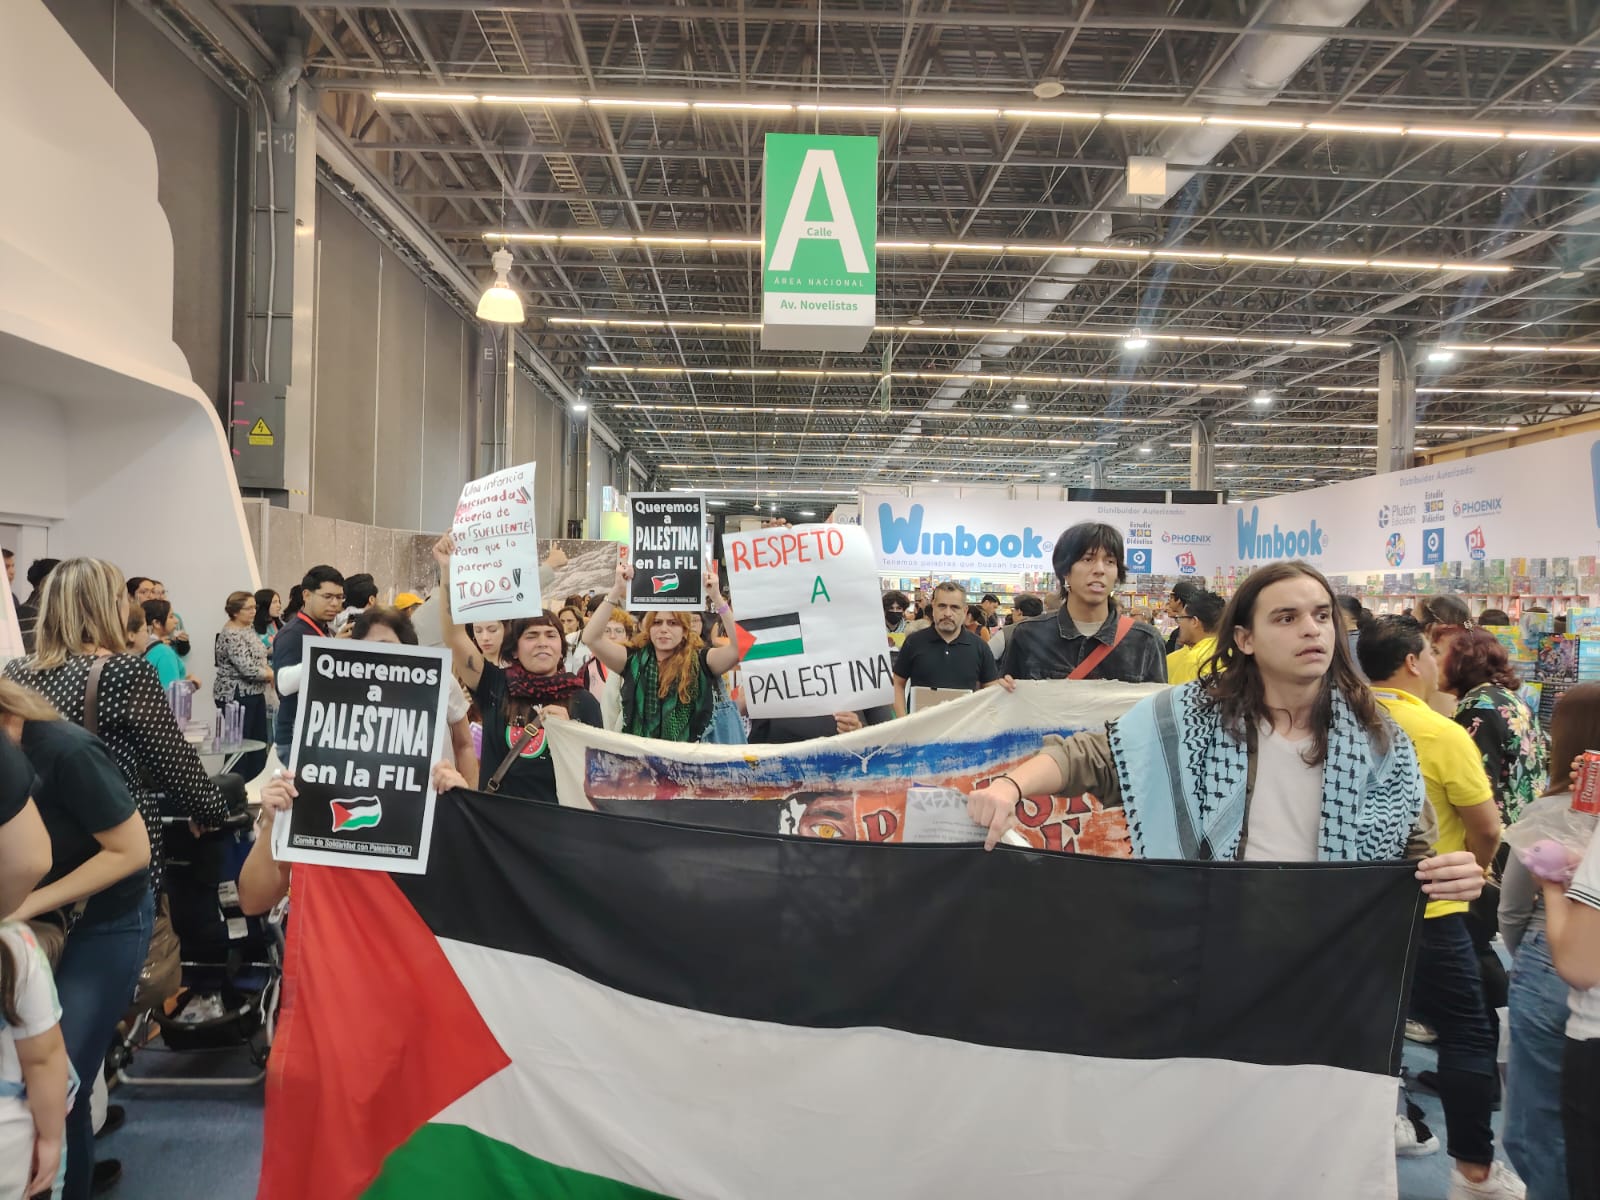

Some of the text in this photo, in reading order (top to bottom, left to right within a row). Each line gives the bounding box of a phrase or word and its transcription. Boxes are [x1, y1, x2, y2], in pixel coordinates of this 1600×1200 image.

[768, 149, 870, 273] A
[807, 227, 832, 237] Calle
[808, 279, 864, 287] NACIONAL
[780, 299, 858, 311] Av. Novelistas
[497, 506, 510, 518] de
[635, 501, 699, 514] Queremos
[1392, 503, 1416, 516] Plutón
[1462, 498, 1502, 513] PHOENIX
[663, 514, 671, 524] a
[878, 502, 1044, 558] Winbook
[1237, 505, 1322, 560] Winbook
[635, 526, 699, 551] PALESTINA
[1172, 534, 1211, 543] PHOENIX
[485, 543, 500, 555] que
[731, 527, 844, 572] RESPETO
[635, 556, 698, 570] en la FIL
[810, 575, 831, 604] A
[316, 654, 438, 685] Queremos
[366, 684, 382, 702] a
[305, 701, 429, 757] PALESTINA
[301, 760, 422, 792] en la FIL
